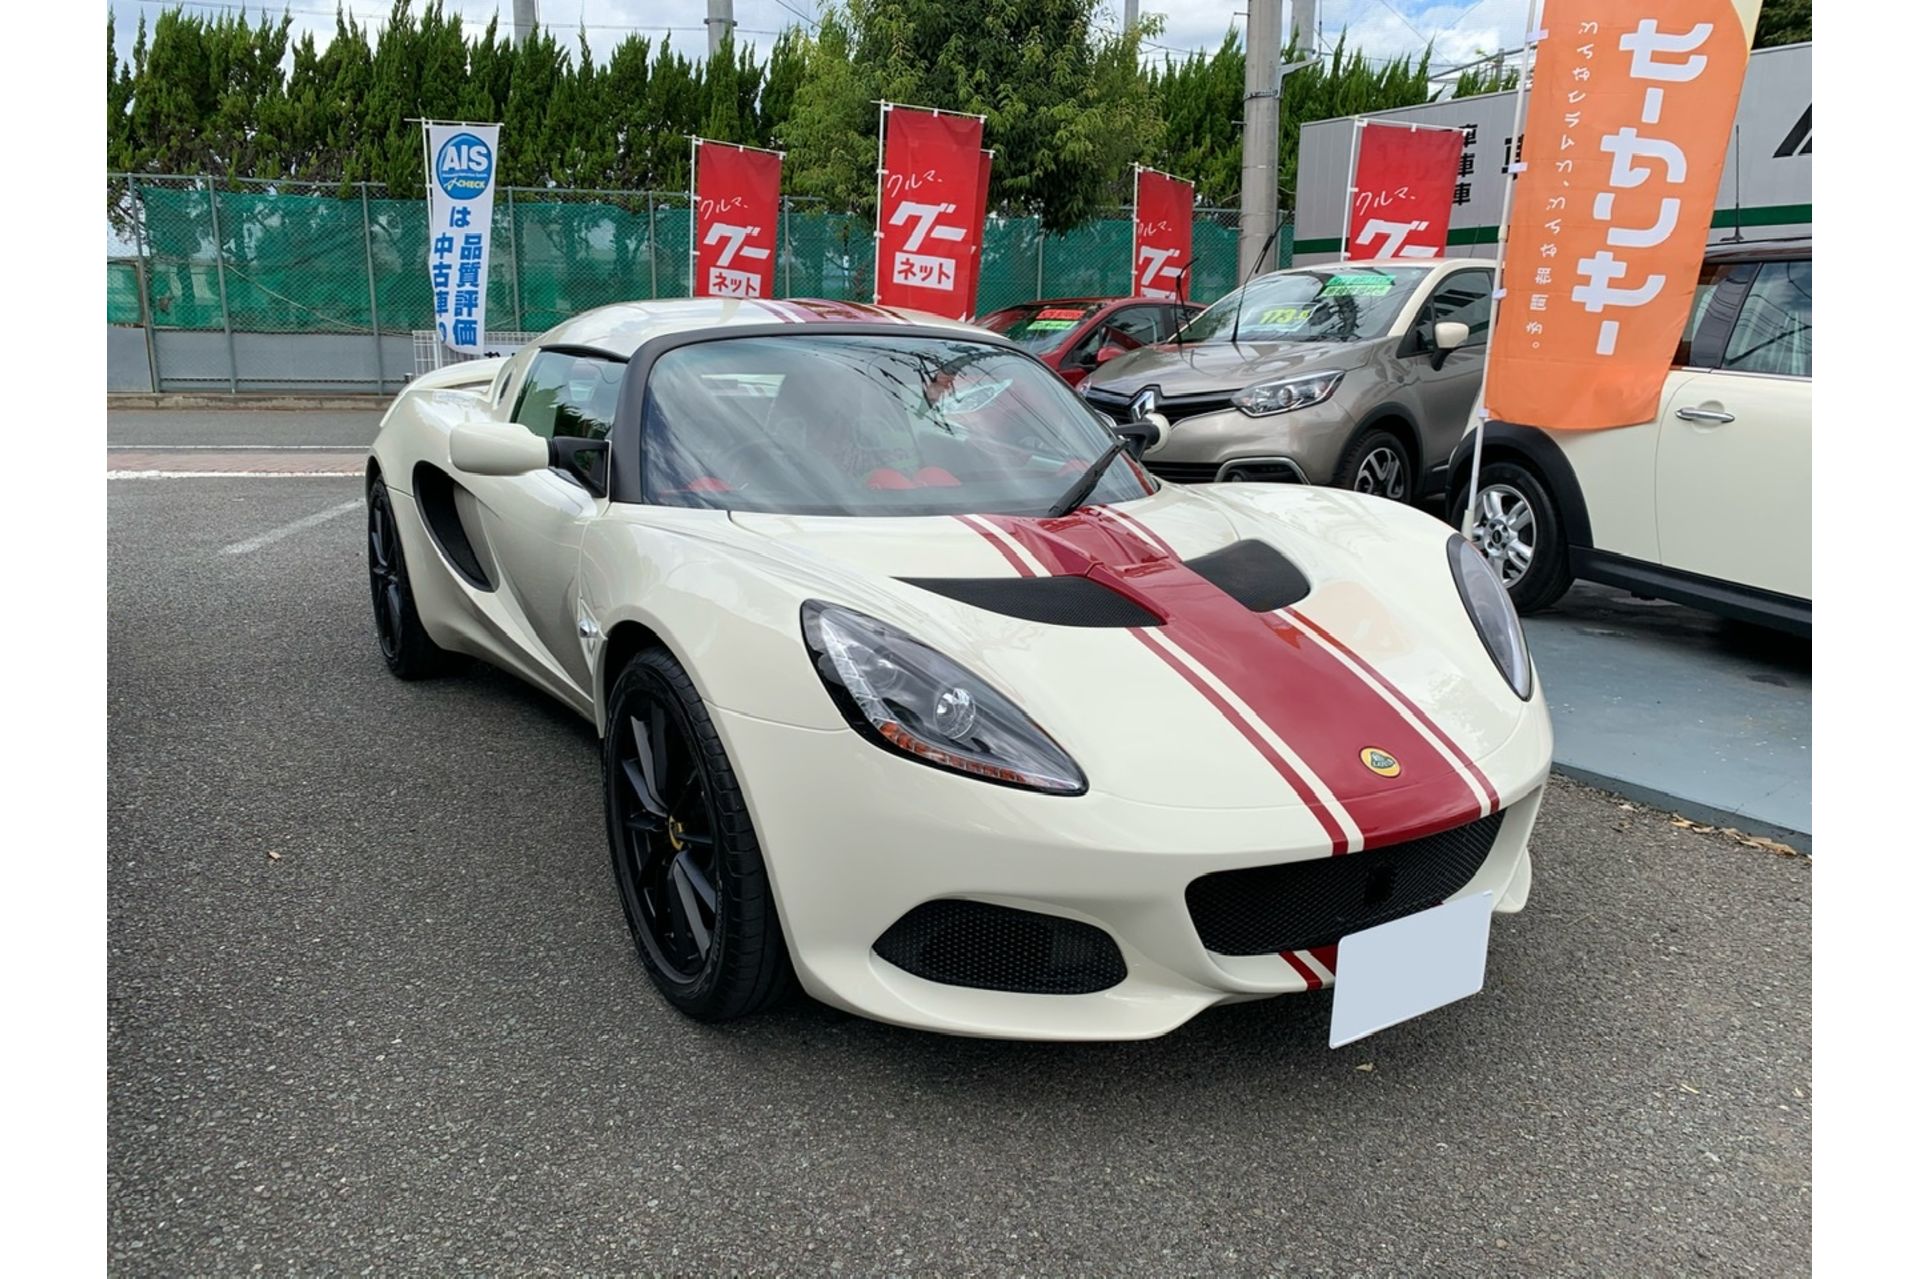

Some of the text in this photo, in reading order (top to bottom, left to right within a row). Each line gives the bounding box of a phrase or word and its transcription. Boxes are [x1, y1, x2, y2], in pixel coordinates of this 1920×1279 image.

[441, 144, 490, 172] AIS
[449, 205, 471, 228] は
[888, 200, 968, 252] グー
[703, 222, 771, 267] グー
[1355, 218, 1440, 260] グー
[712, 271, 757, 296] ネット
[897, 257, 951, 285] ネット
[453, 232, 483, 347] 品質評価
